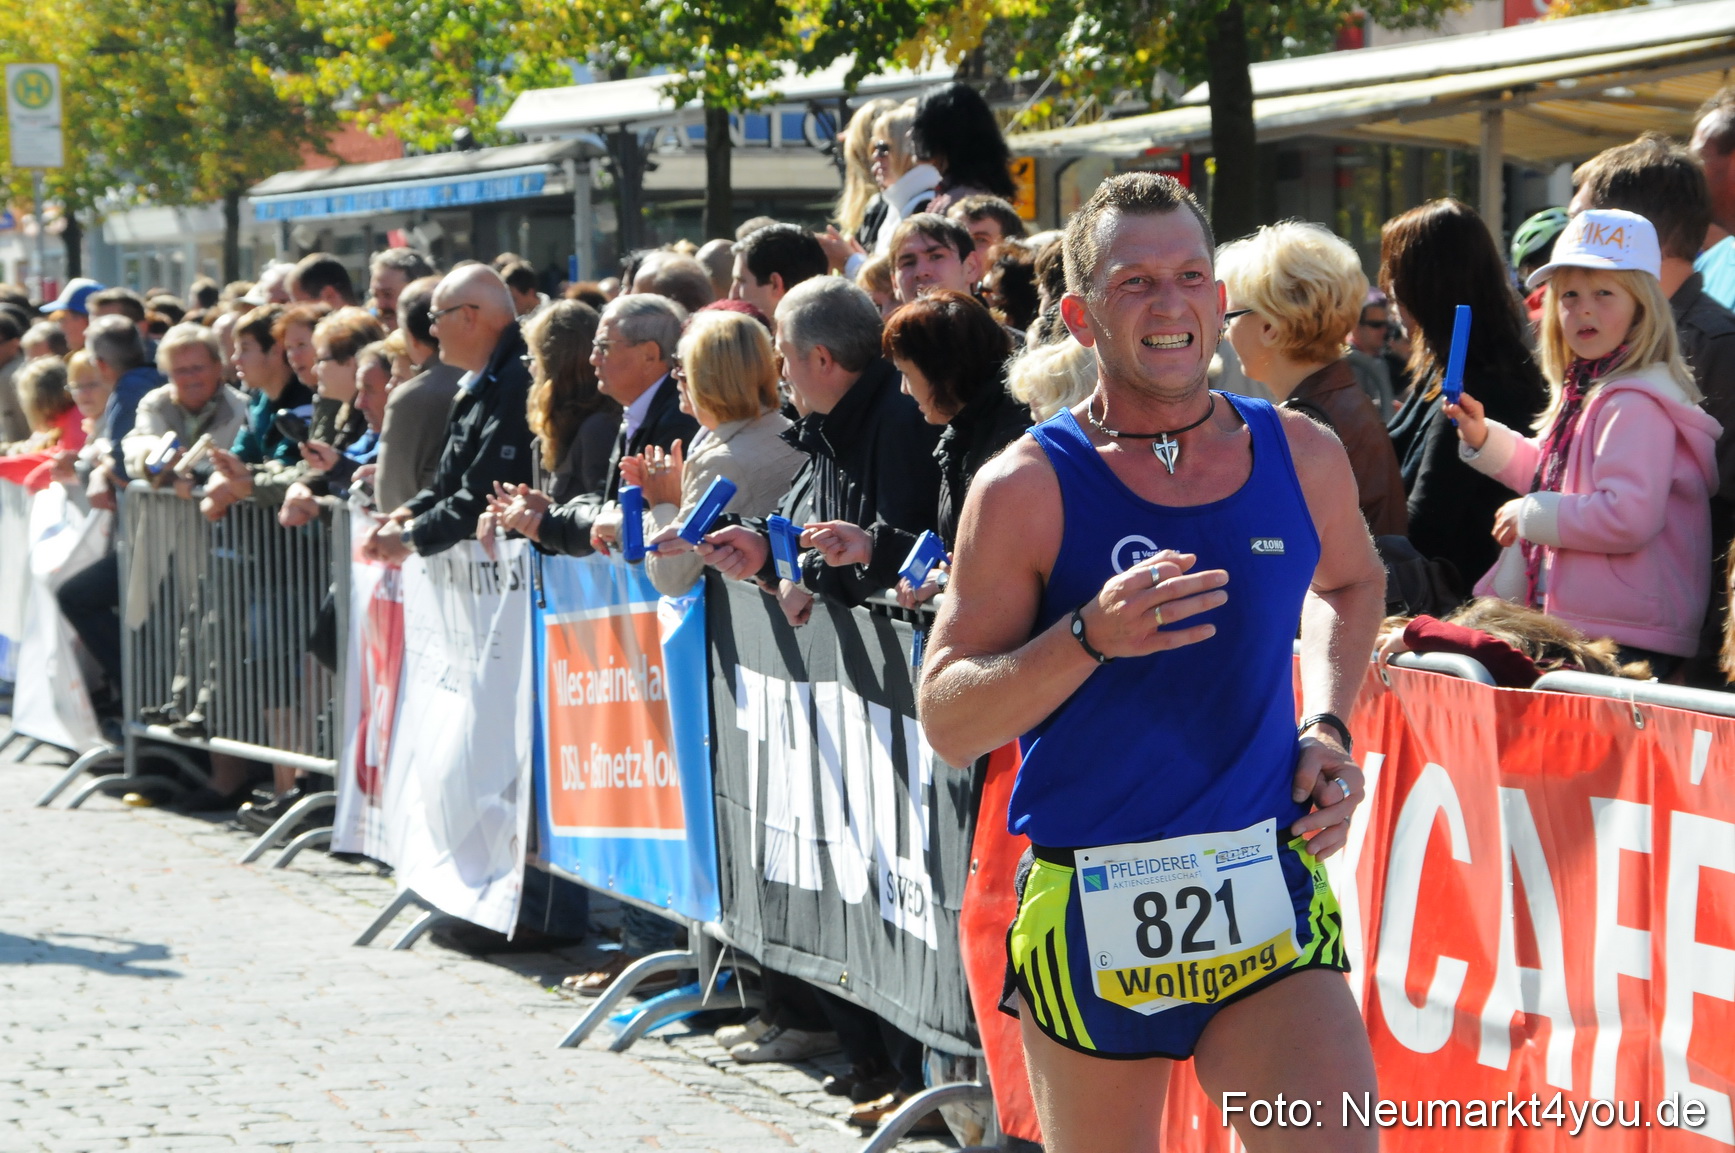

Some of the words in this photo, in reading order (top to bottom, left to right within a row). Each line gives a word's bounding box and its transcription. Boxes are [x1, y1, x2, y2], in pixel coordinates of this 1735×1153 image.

[553, 659, 584, 706] lles
[1111, 853, 1199, 879] PFLEIDERER
[1113, 870, 1203, 889] AKTIENGESELLSCHAFT
[1133, 878, 1242, 959] 821
[1099, 954, 1108, 967] C
[1116, 943, 1278, 1003] Wolfgang
